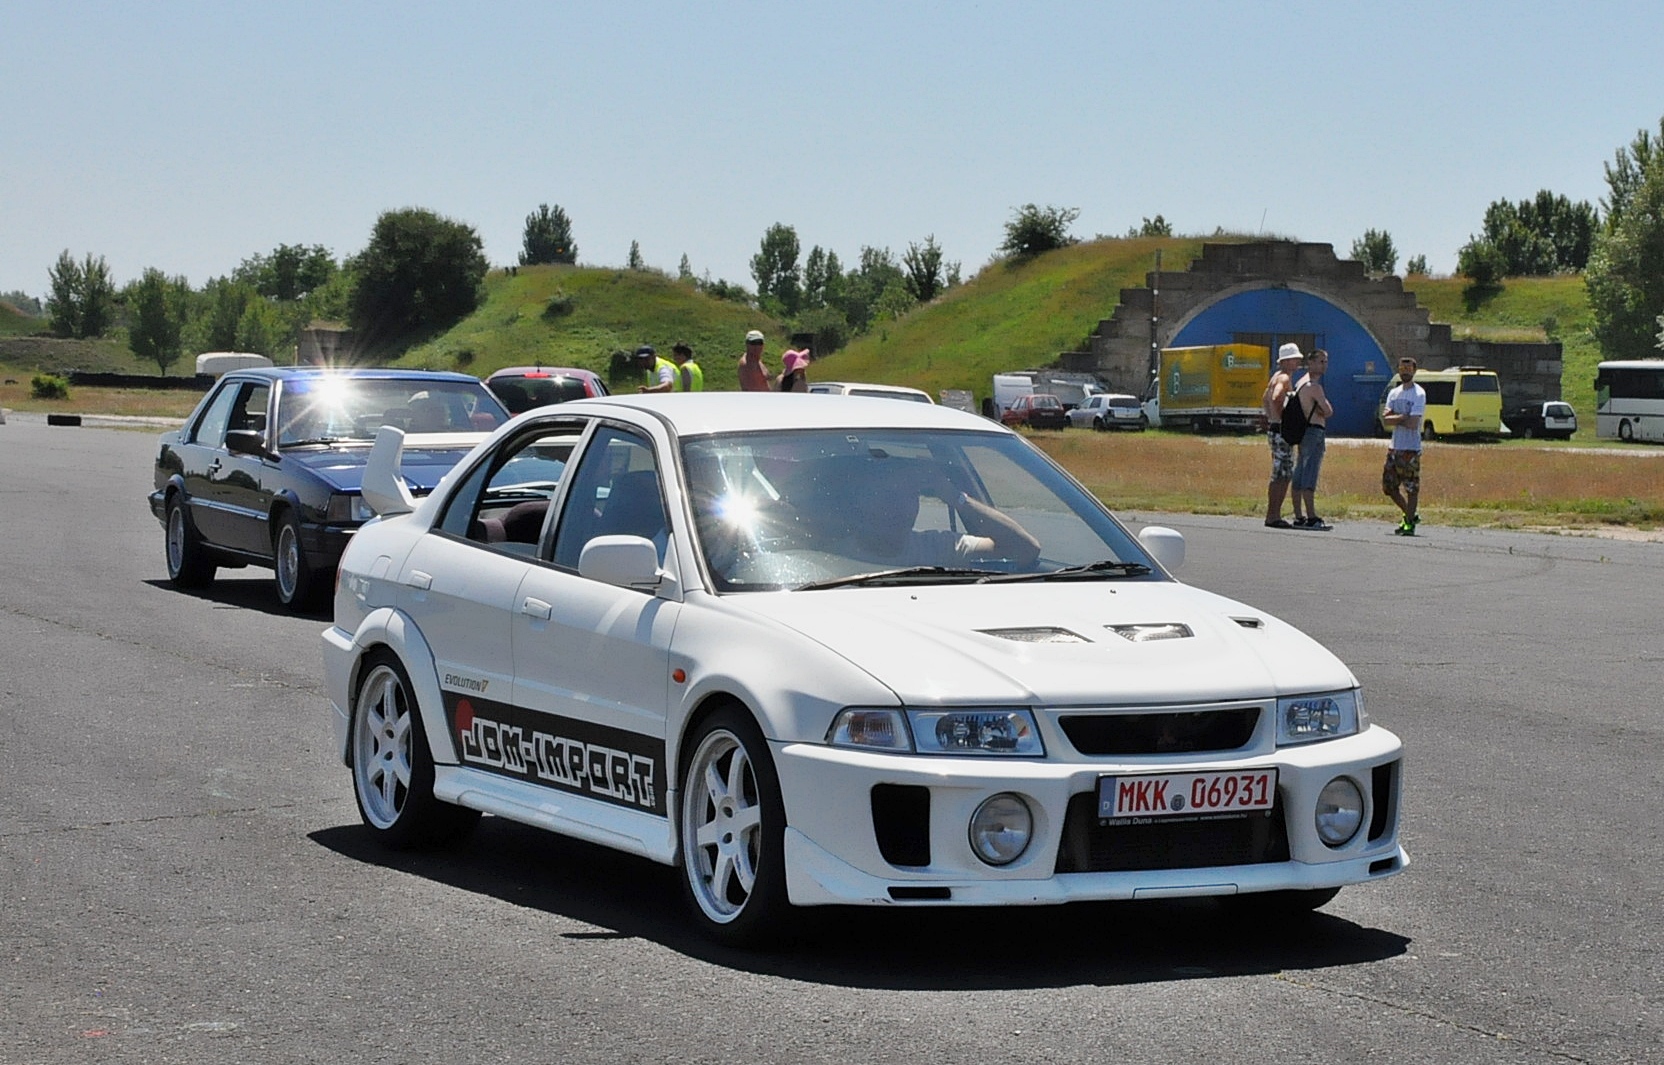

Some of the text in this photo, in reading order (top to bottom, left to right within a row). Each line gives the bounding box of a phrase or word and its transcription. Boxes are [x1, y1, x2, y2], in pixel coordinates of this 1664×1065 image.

[445, 673, 480, 691] EVOLUTION
[1118, 774, 1268, 813] MKK 06931
[1132, 817, 1153, 825] Duna
